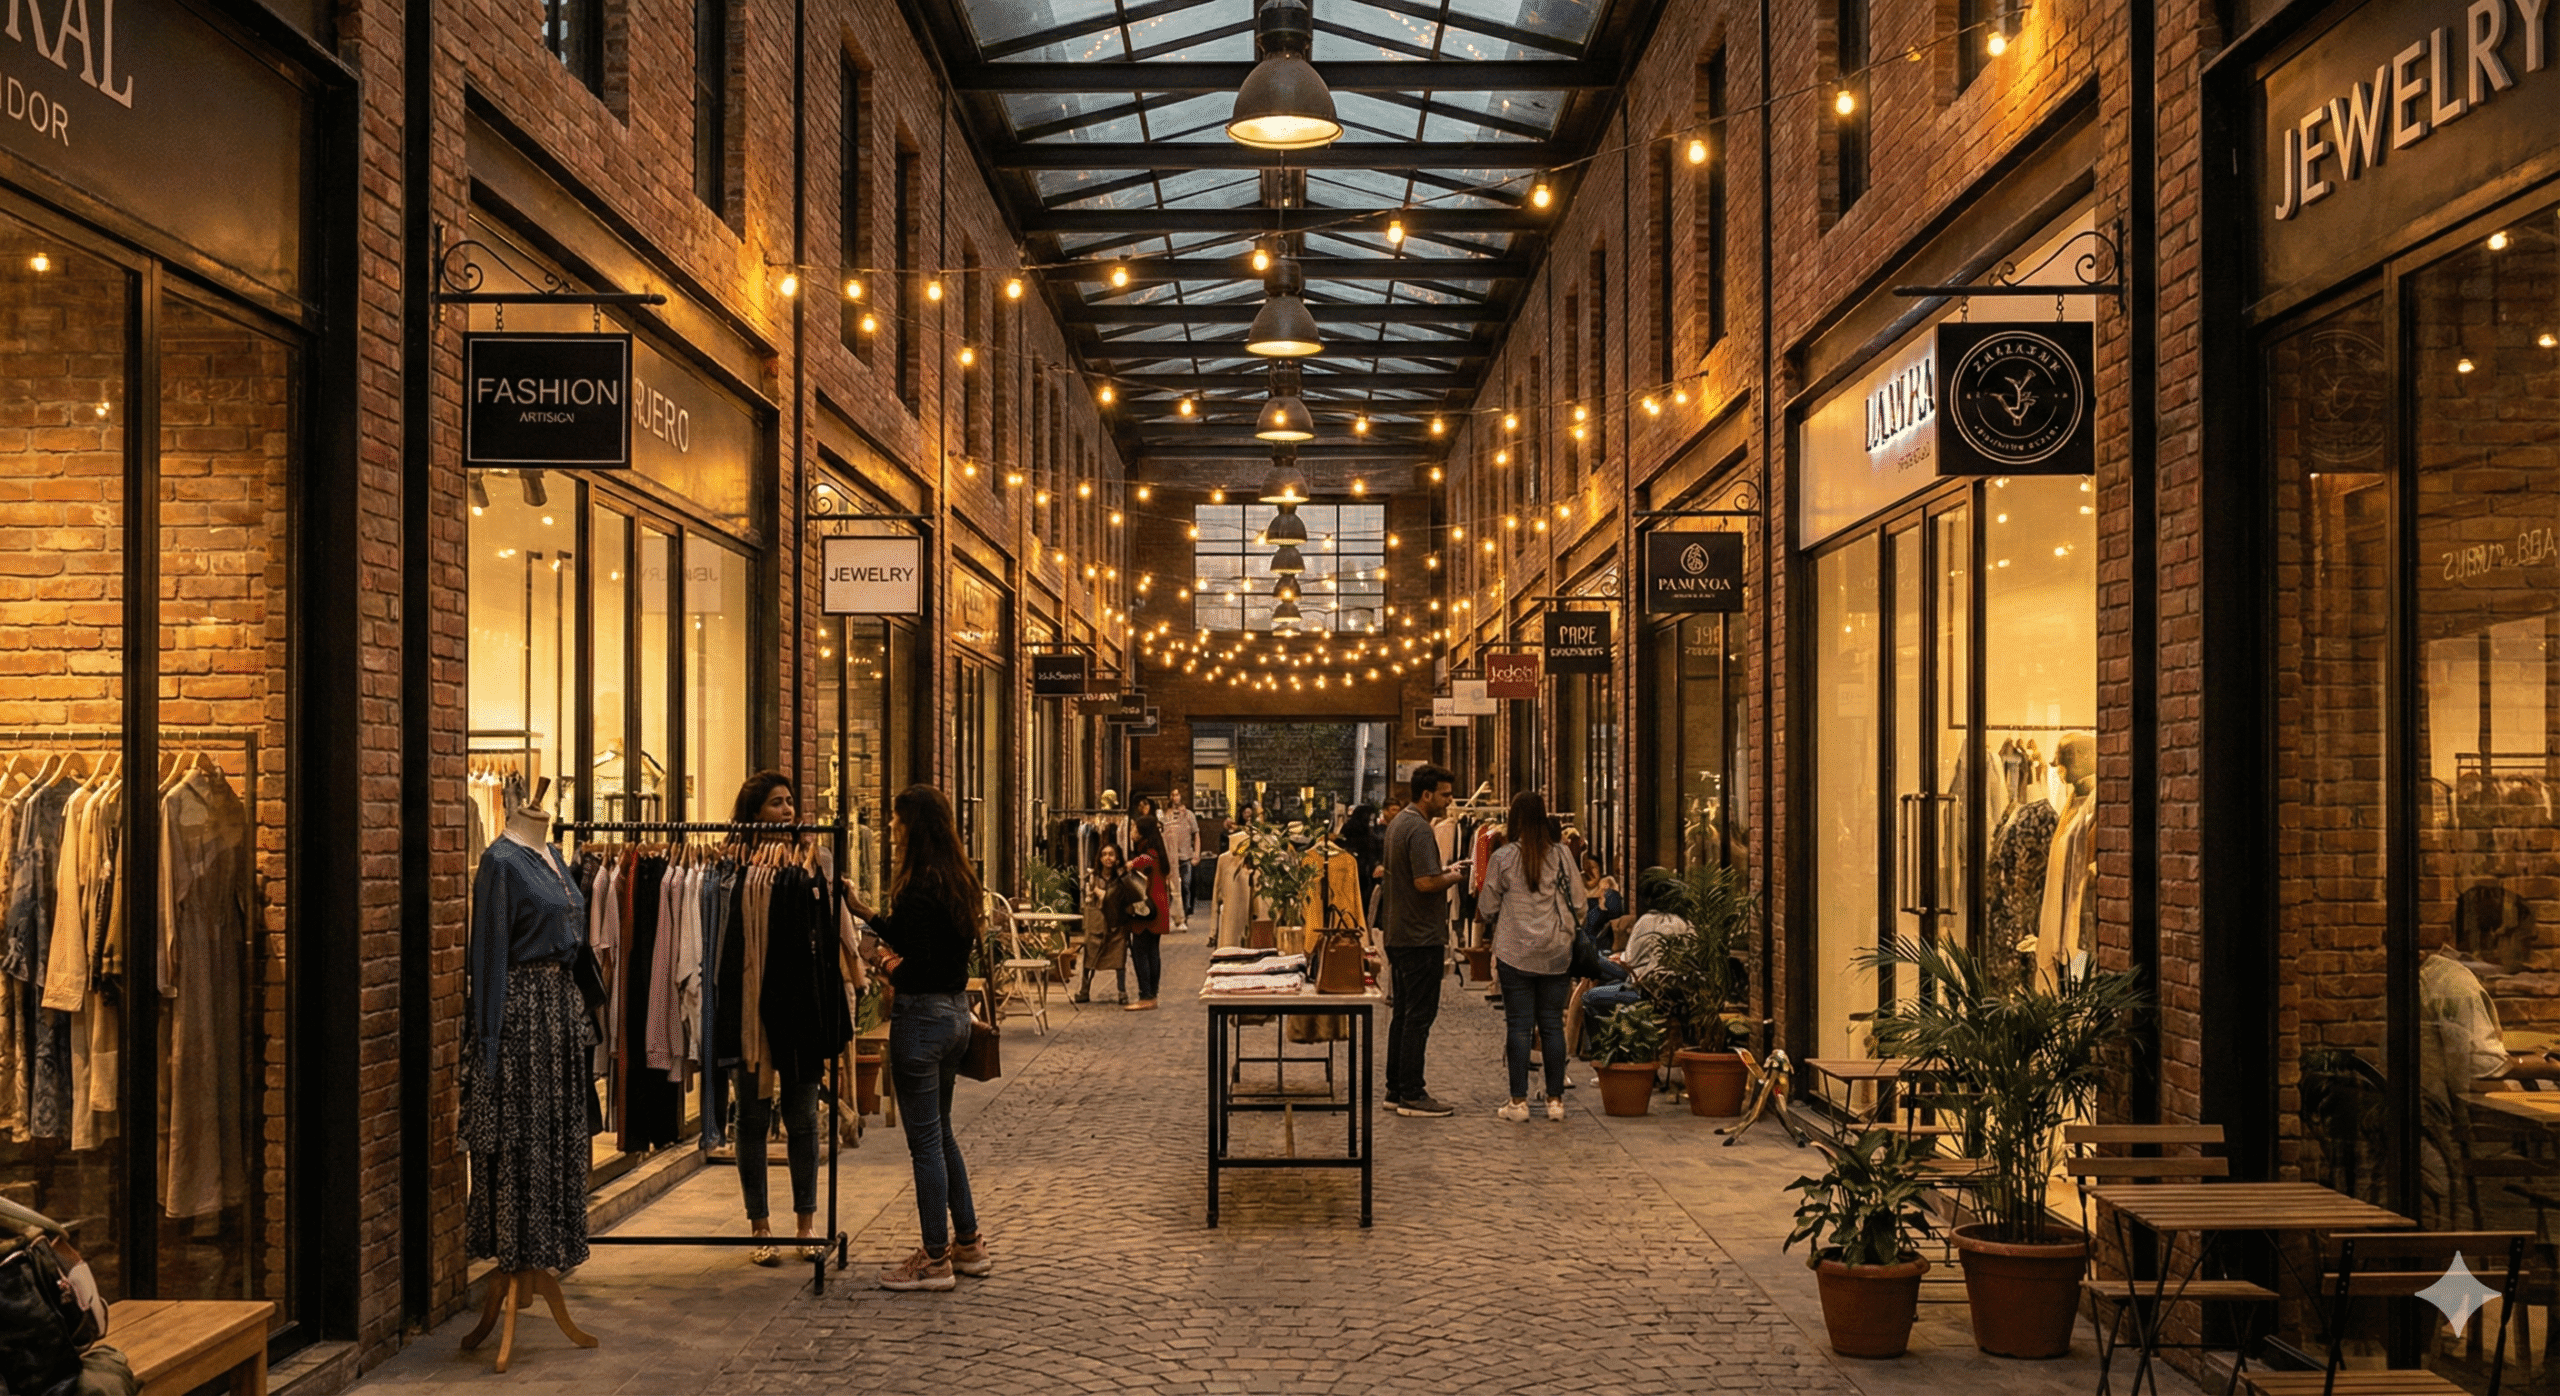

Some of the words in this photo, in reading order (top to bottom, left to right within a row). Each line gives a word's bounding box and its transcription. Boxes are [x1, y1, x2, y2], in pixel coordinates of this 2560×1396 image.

[2275, 0, 2549, 220] JEWELRY
[477, 377, 618, 405] FASHION
[829, 566, 914, 582] JEWELRY
